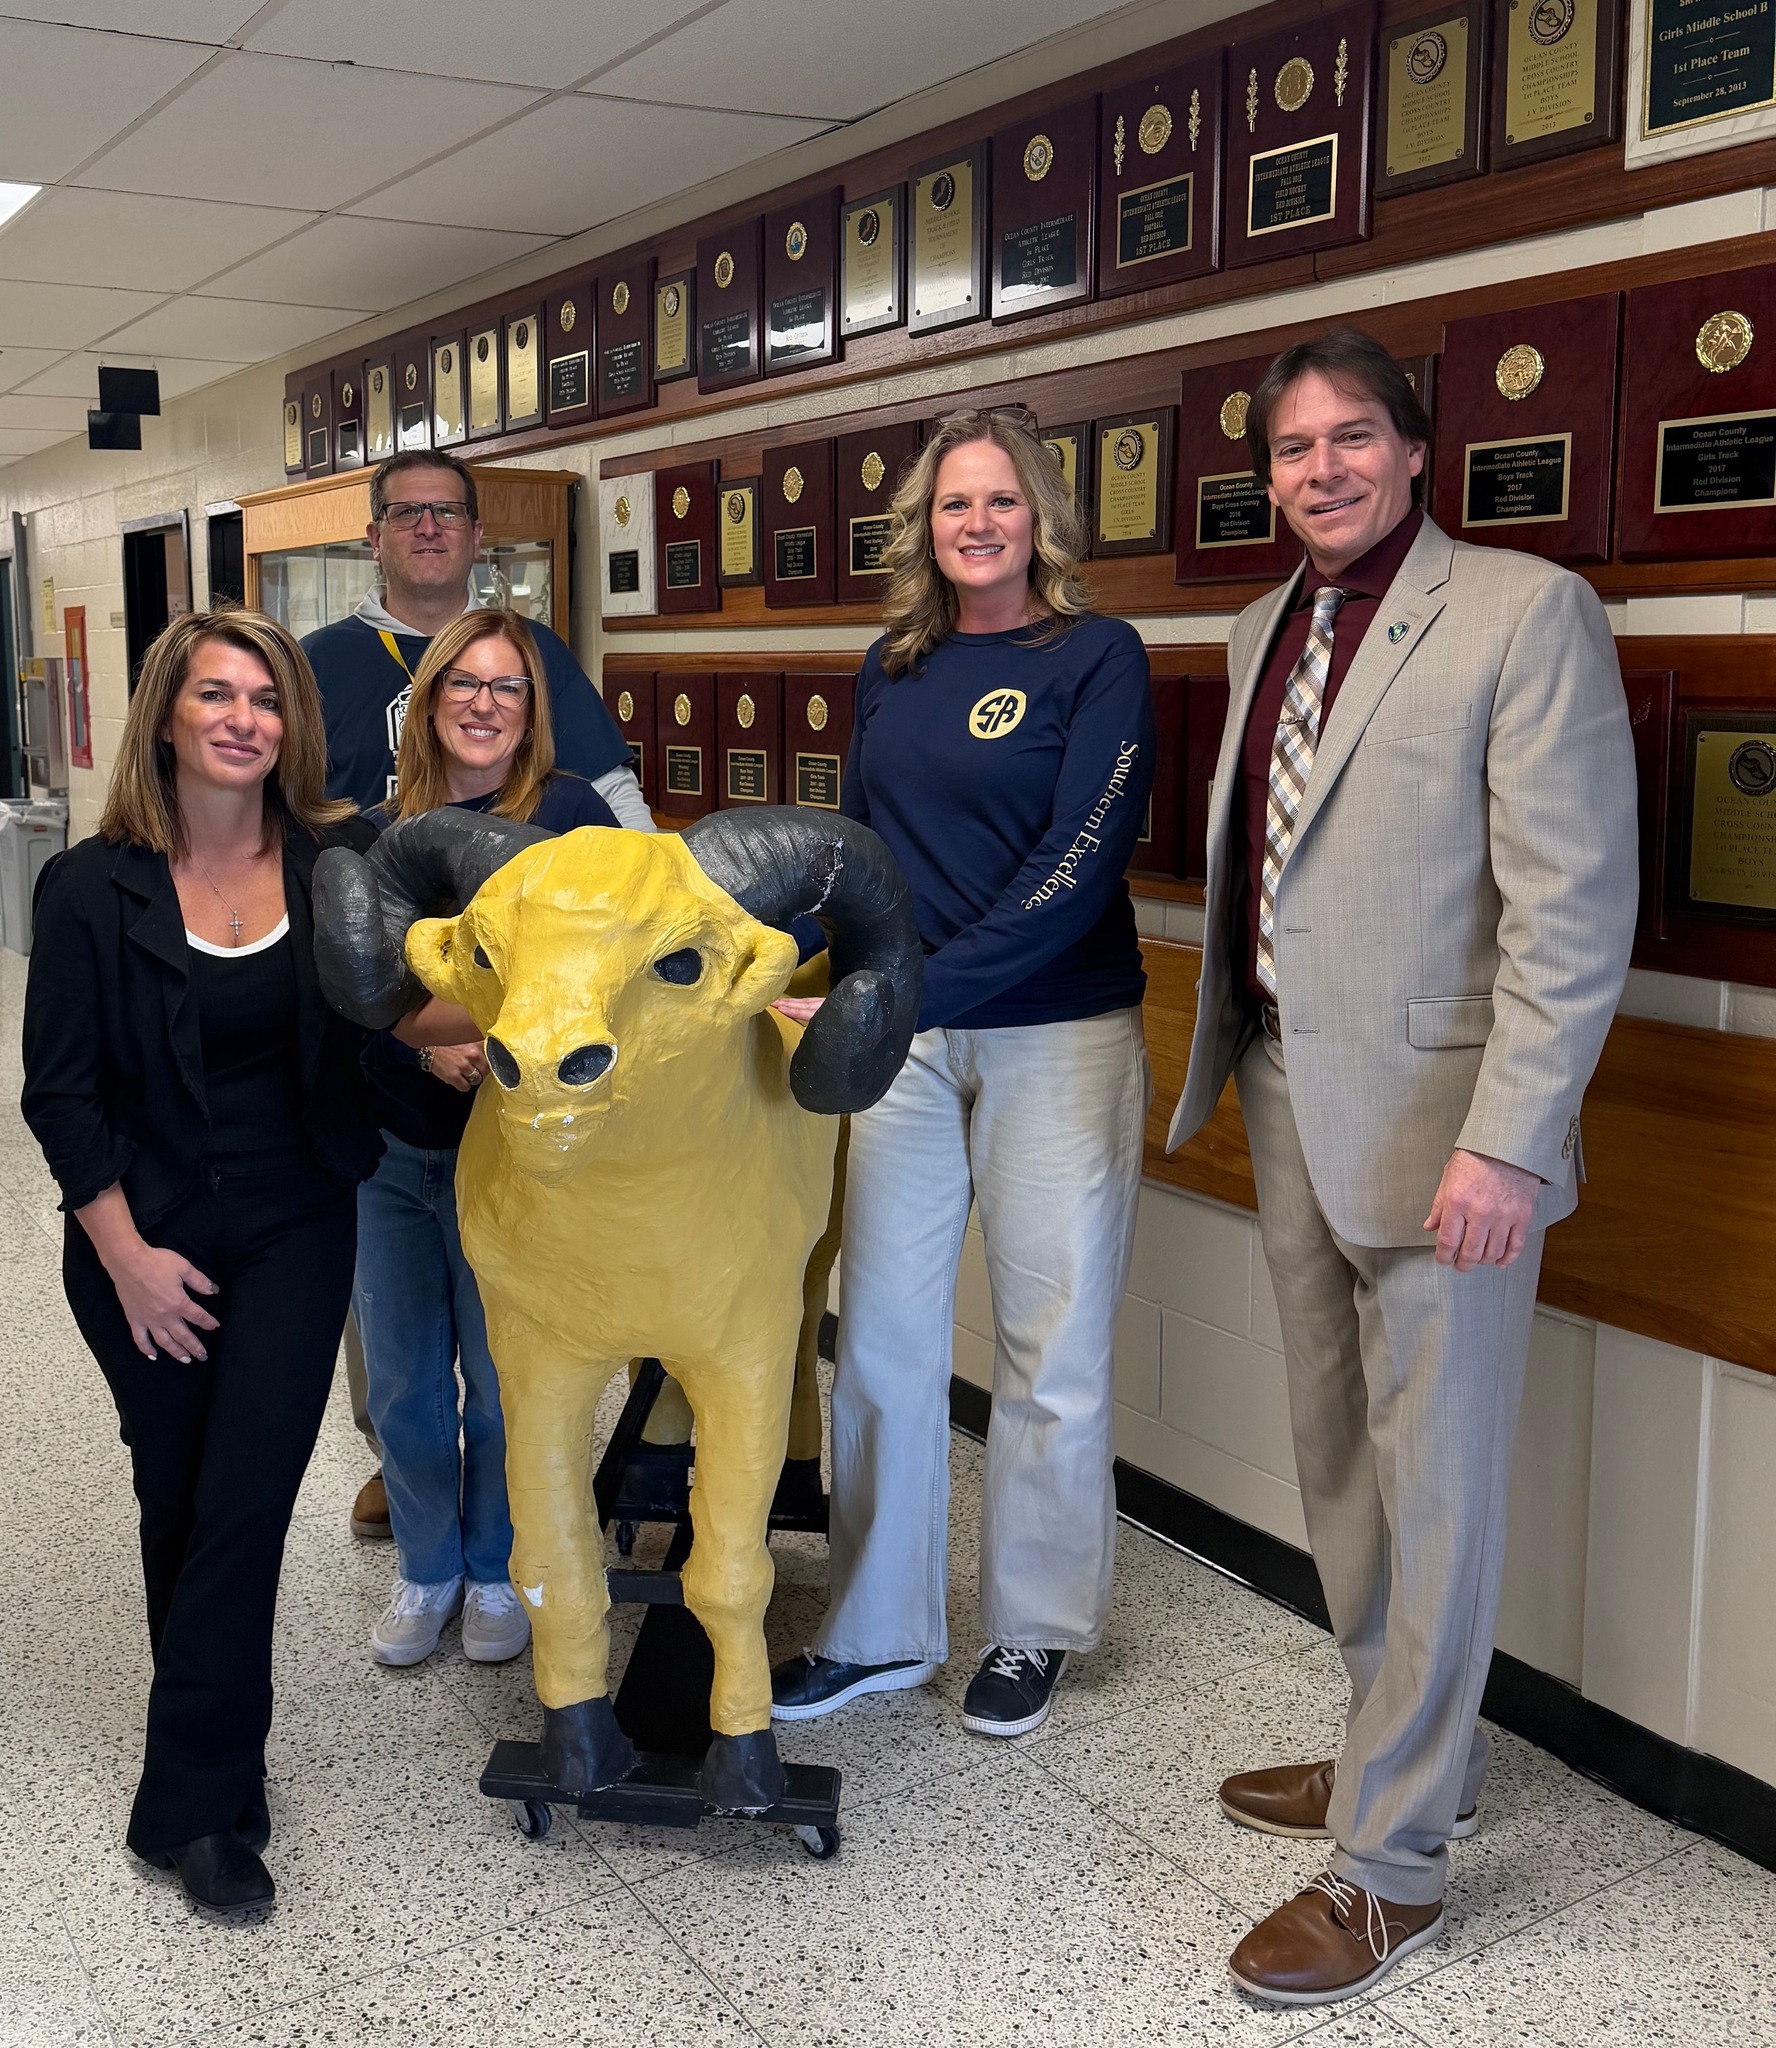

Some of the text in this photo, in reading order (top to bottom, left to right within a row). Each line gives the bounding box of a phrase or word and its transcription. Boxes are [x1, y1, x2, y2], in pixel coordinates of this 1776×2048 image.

[1659, 2, 1768, 41] Girls Middle School B
[1524, 42, 1578, 63] OCEAN COUNTY
[1674, 46, 1750, 74] 1st Place Team
[1522, 51, 1578, 72] MIDDLE SCHOOL
[1522, 60, 1578, 82] CROSS COUNTRY
[1522, 70, 1579, 91] CHAMPIONSHIPS
[1534, 85, 1555, 97] PLACE
[1558, 79, 1576, 89] TEAM
[1541, 94, 1559, 104] BOYS
[1673, 81, 1747, 107] September 28, 2013
[1540, 99, 1572, 112] DIVISION
[1542, 122, 1556, 130] 2013
[1276, 150, 1308, 165] OCEAN COUNTY
[1256, 156, 1330, 182] INTERMEDIATE ATHLETIC LEAGUE
[1281, 177, 1291, 186] FALL
[1275, 184, 1307, 199] FIELD HOCKEY
[1286, 196, 1306, 207] DIVISION
[1270, 206, 1310, 223] 1ST PLACE
[1719, 427, 1746, 436] County
[1666, 436, 1774, 451] Intermediate Athletic League
[1718, 451, 1738, 459] Track
[1472, 462, 1510, 472] Intermediate
[1512, 459, 1536, 467] Athletic
[1709, 465, 1726, 473] 2017
[1710, 476, 1741, 484] Division
[1695, 488, 1738, 496] Champions
[1496, 505, 1532, 513] Champions
[1021, 740, 1139, 910] Southern Excellence
